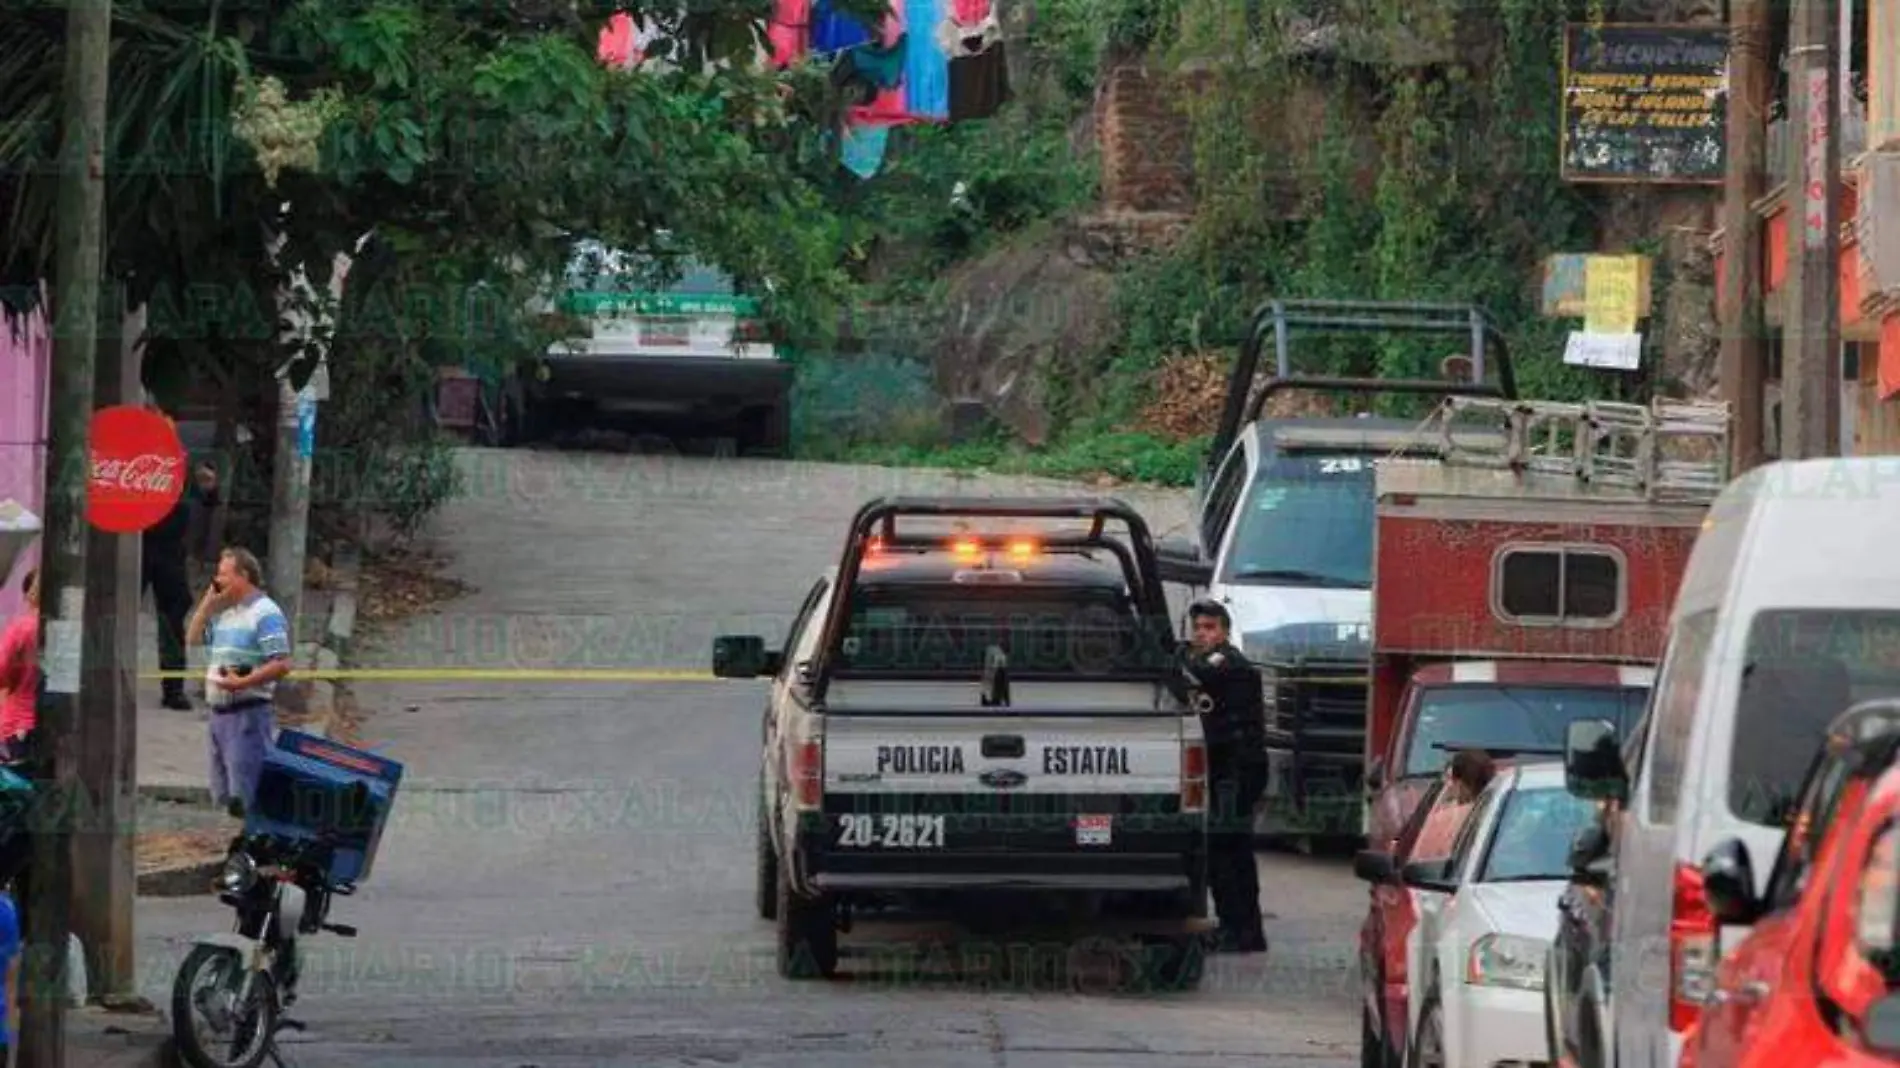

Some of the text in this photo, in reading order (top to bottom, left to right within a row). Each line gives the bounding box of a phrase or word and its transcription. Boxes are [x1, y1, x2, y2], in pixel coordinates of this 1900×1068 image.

[878, 745, 1131, 775] POLICIA ESTATAL
[838, 812, 945, 847] 20-2621
